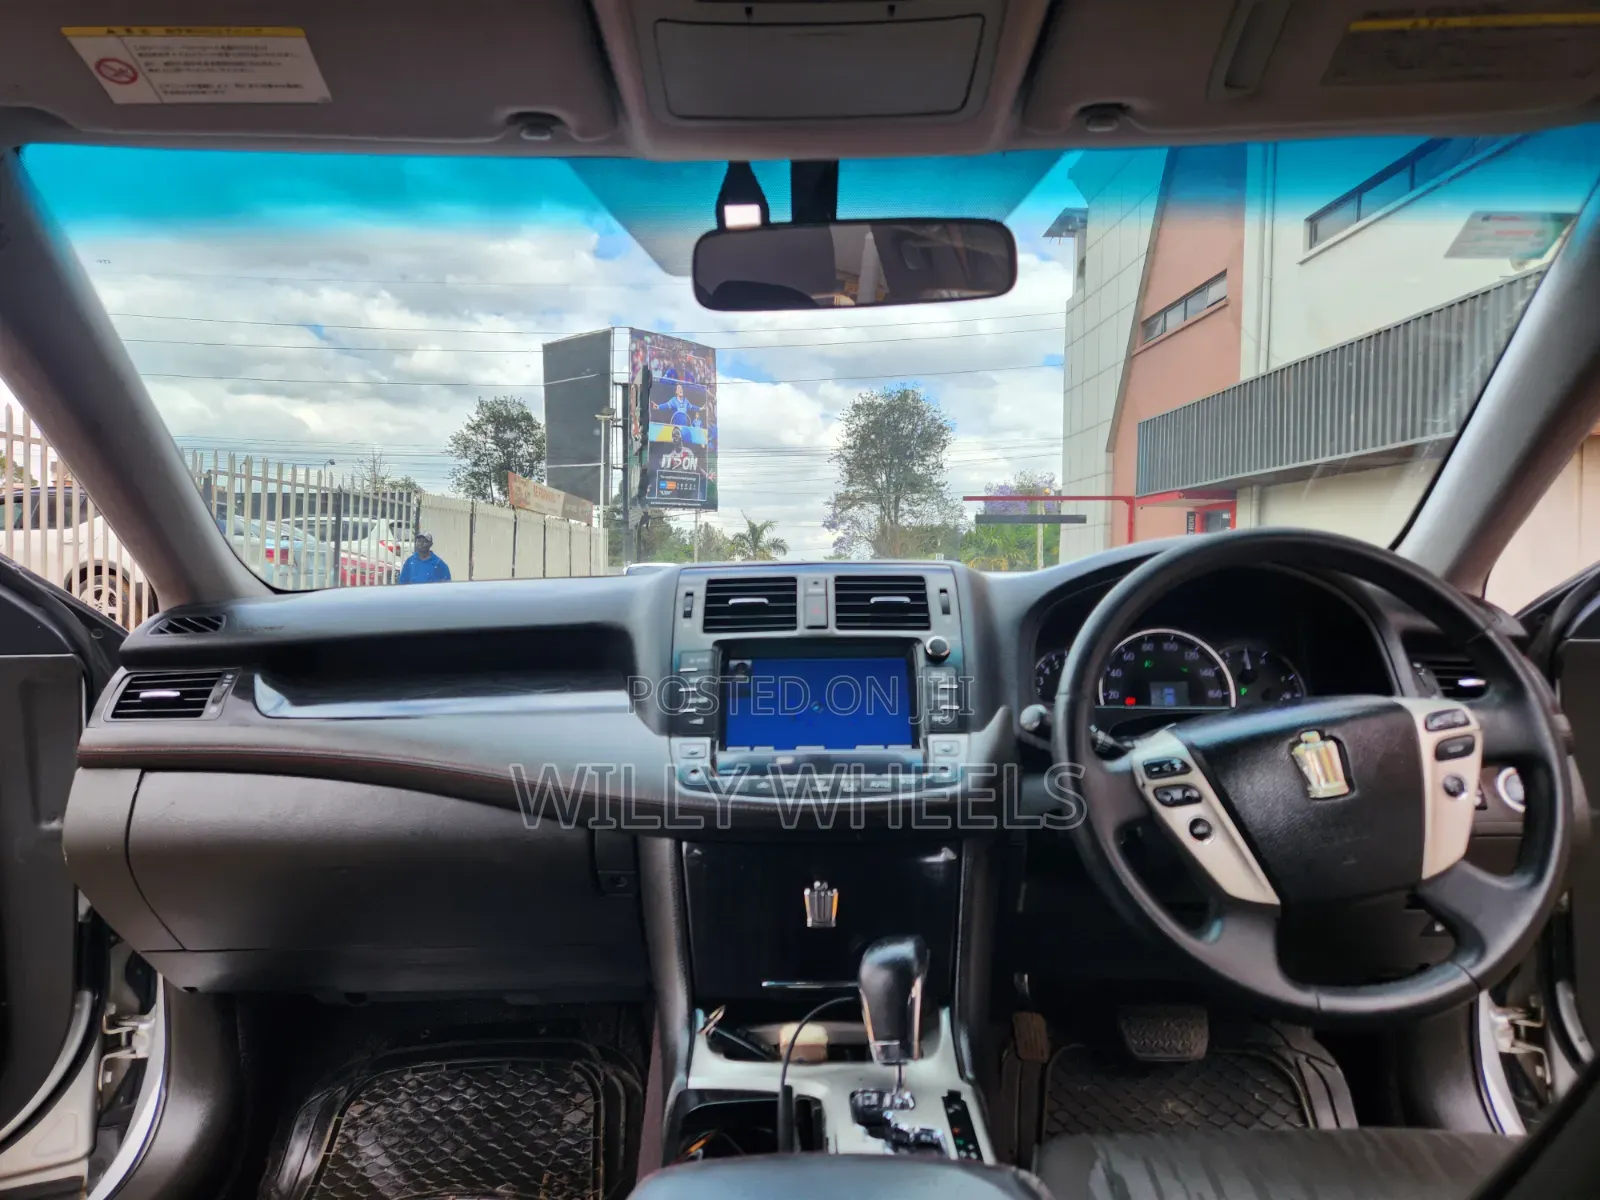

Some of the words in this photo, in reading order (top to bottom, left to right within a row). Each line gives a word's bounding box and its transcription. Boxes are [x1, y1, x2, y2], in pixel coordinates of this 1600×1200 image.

[1142, 643, 1154, 652] 80
[1163, 642, 1178, 651] 100
[1123, 652, 1135, 661] 60
[1184, 651, 1199, 660] 120
[1110, 669, 1122, 677] 40
[1108, 691, 1119, 699] 20
[1208, 690, 1222, 699] 160
